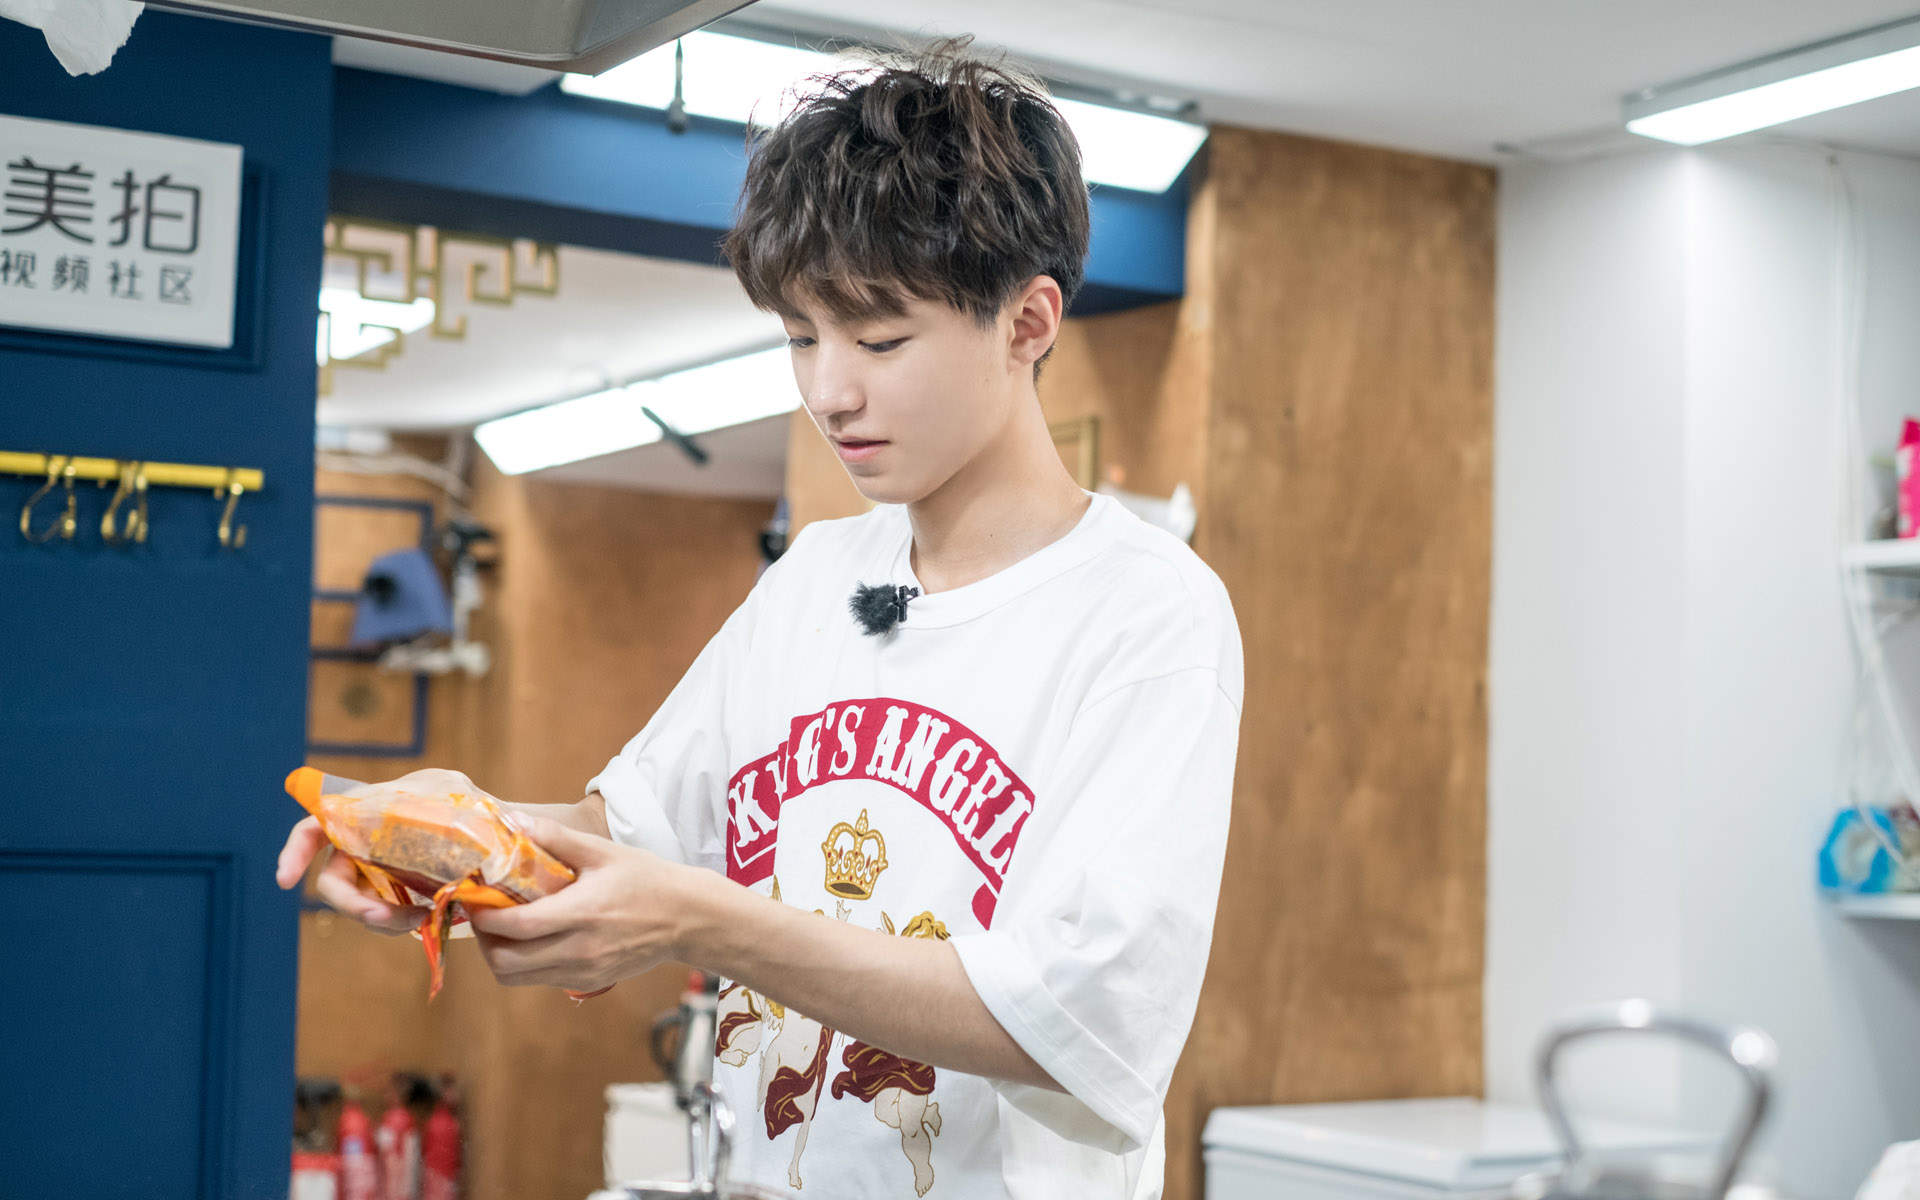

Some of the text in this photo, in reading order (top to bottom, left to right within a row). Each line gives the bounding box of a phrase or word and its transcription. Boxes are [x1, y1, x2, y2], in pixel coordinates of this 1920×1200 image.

[1, 156, 202, 254] 美拍
[0, 248, 194, 306] 视频社区
